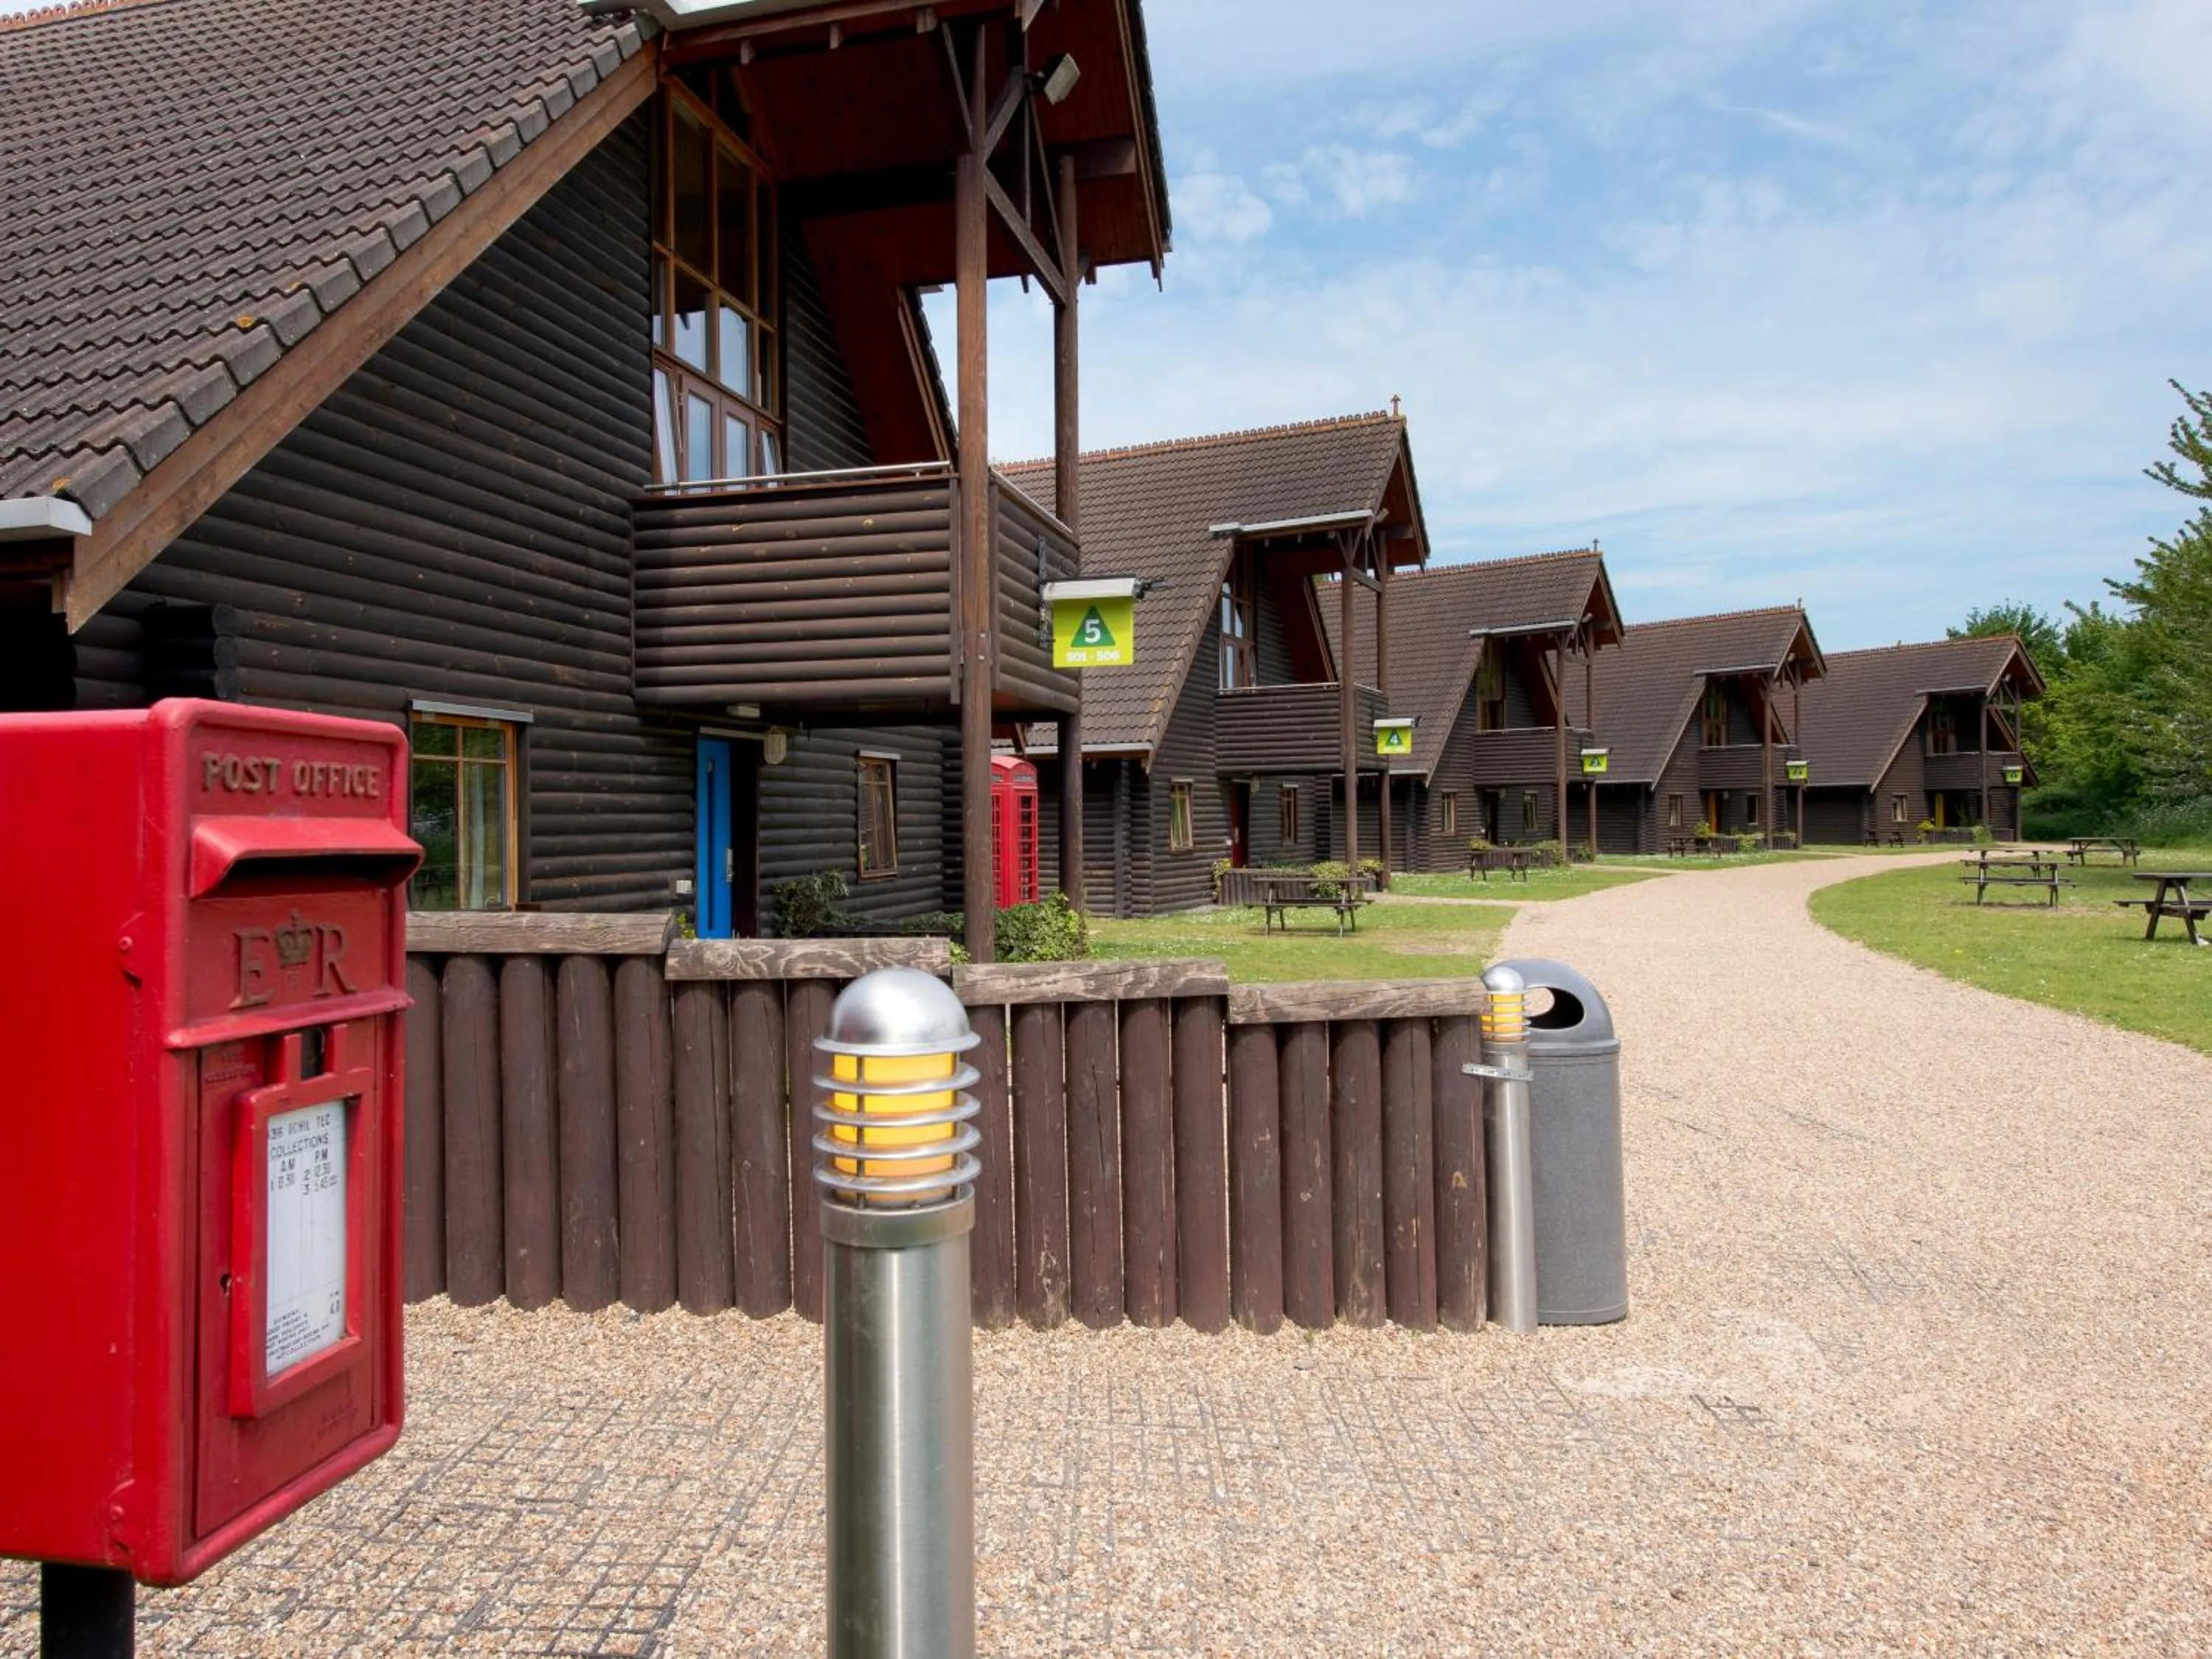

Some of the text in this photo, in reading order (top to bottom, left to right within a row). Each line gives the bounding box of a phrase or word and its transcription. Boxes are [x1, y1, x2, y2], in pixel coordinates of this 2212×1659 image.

[1085, 619, 1101, 643] 5
[1390, 734, 1398, 744] 4
[202, 751, 380, 800] POST OFFICE
[270, 1132, 329, 1158] COLLECTIONS
